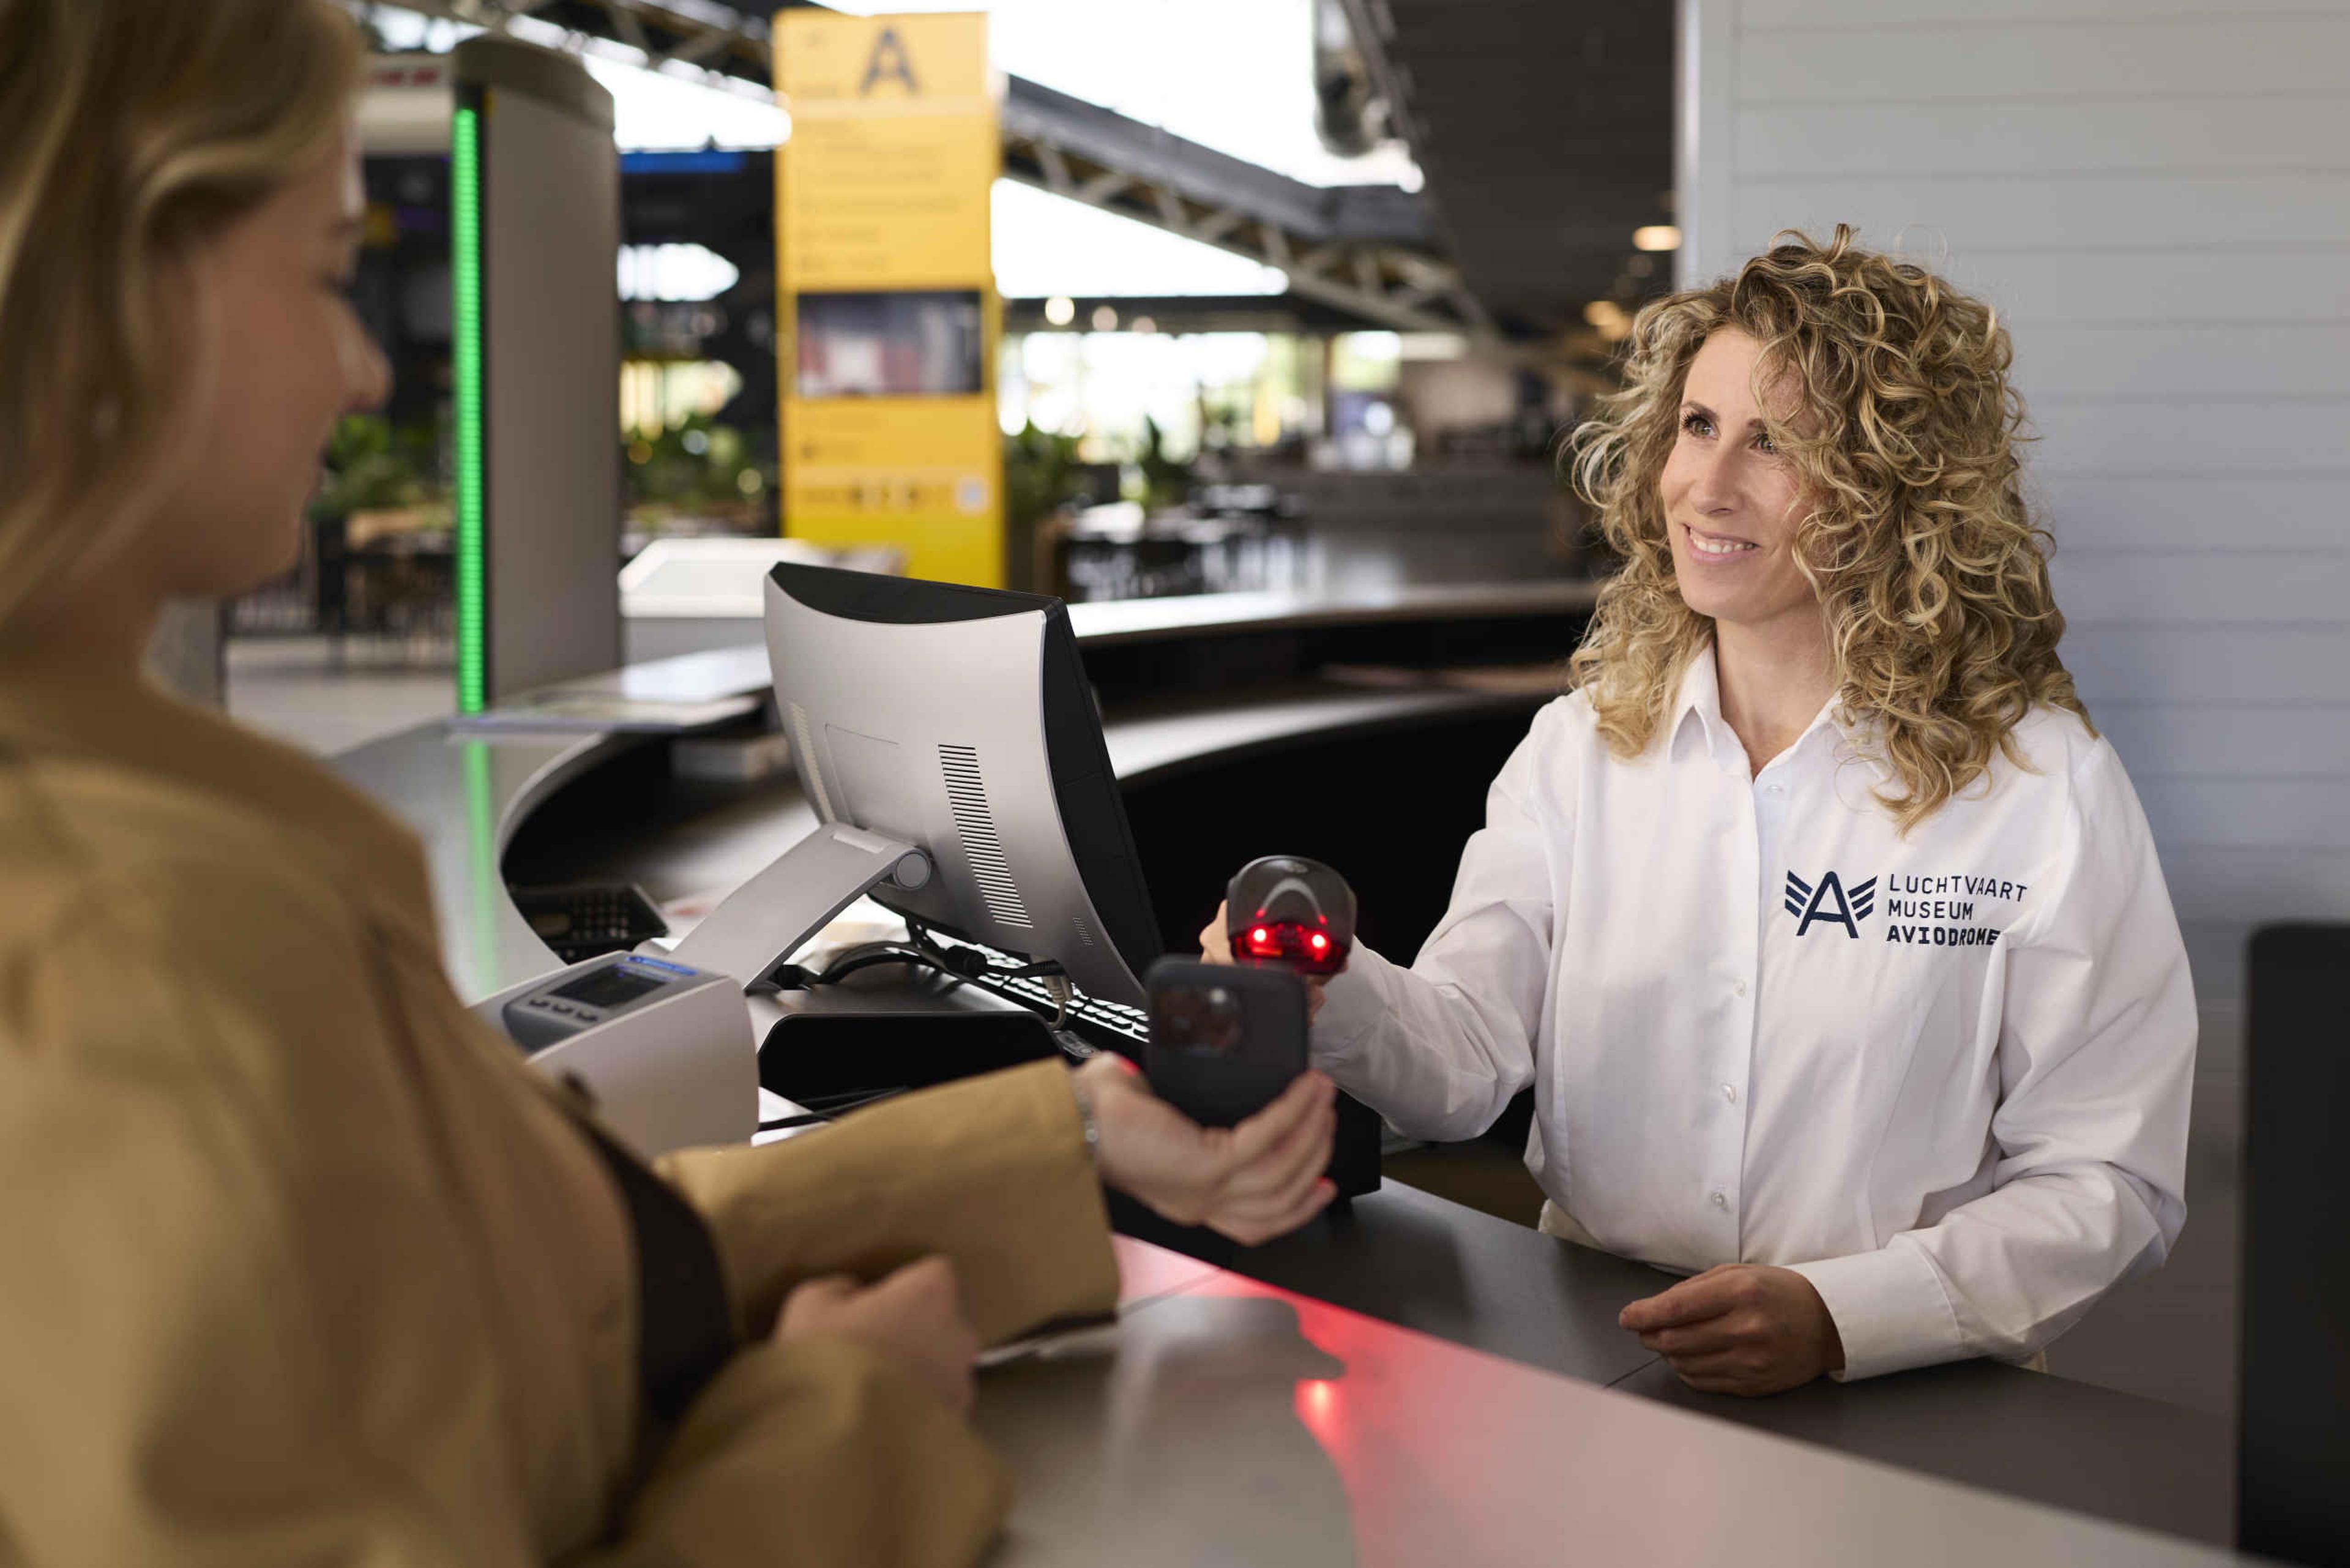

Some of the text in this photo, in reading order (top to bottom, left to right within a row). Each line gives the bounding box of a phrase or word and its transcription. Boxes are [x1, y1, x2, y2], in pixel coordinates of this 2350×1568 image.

[1889, 873, 2027, 903] LUCHTVAART
[1888, 899, 1974, 920] MUSEUM
[1886, 925, 2001, 946] AVIODROME
